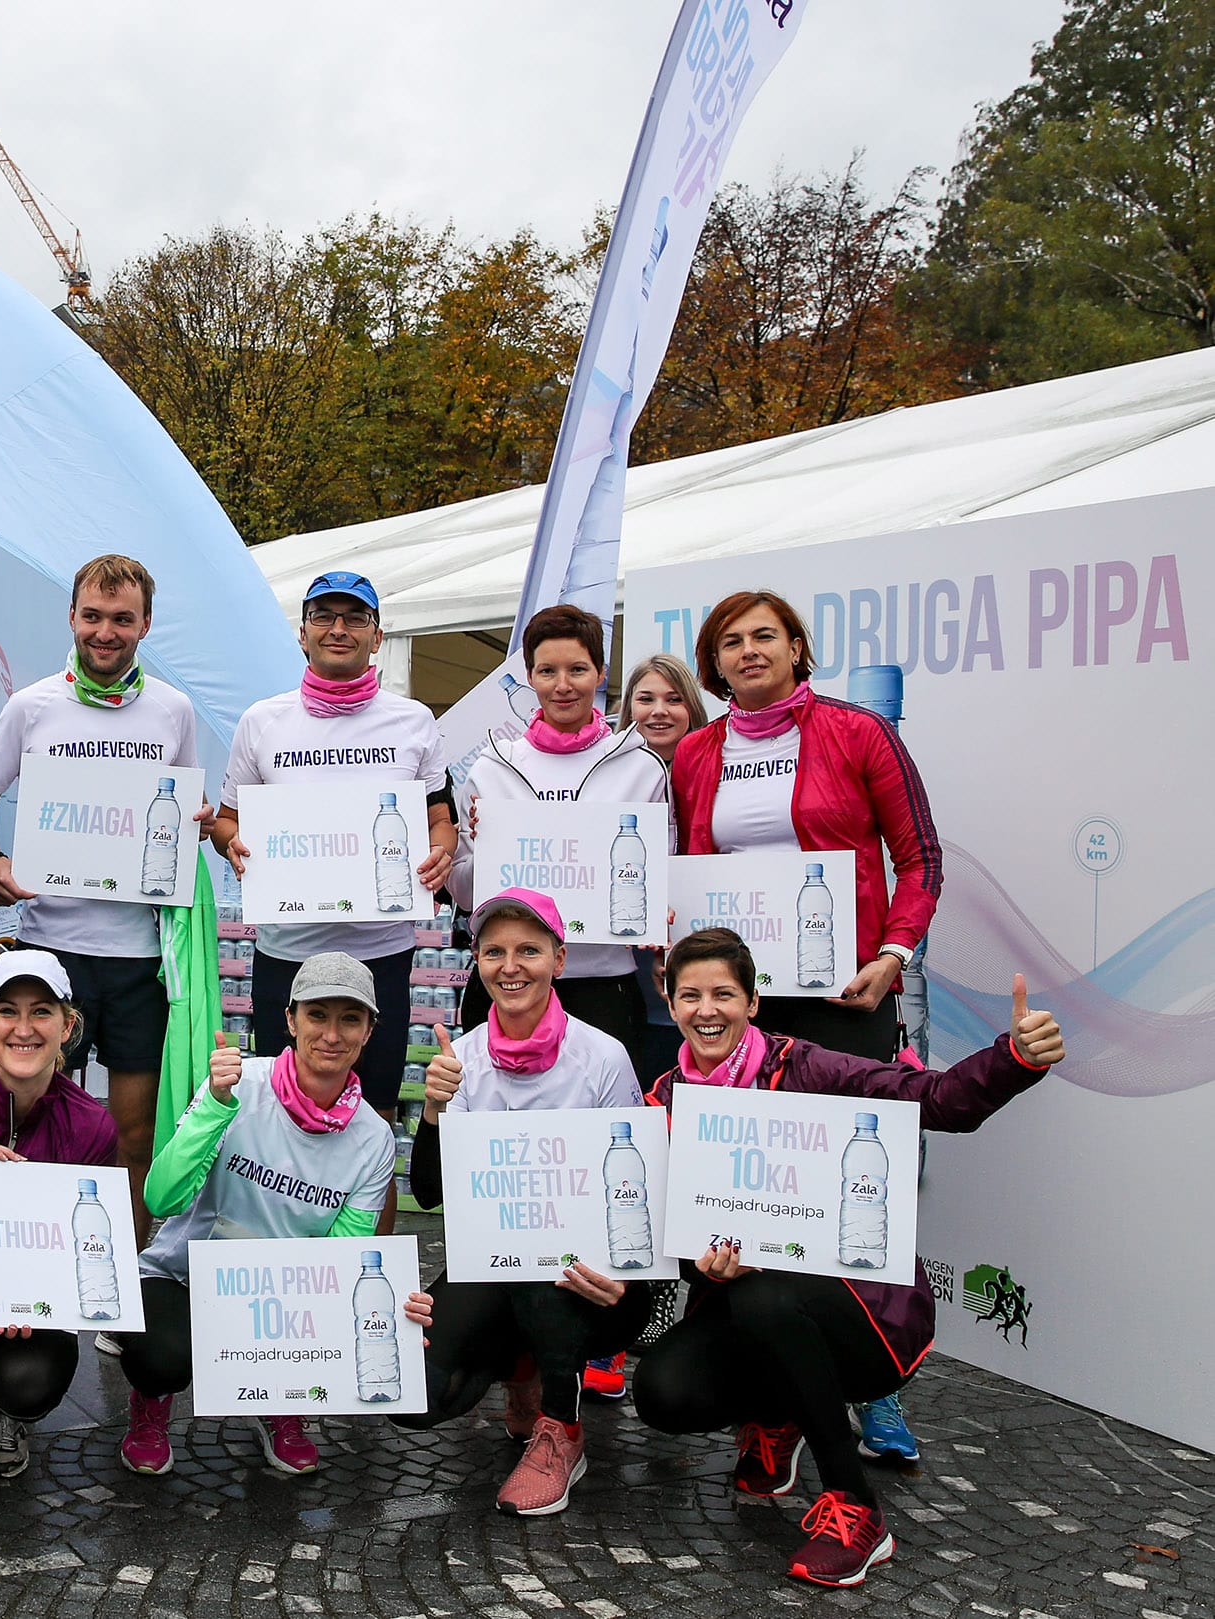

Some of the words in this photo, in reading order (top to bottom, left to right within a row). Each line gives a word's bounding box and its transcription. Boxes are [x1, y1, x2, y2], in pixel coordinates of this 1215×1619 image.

[812, 574, 1005, 681] DRUGA
[1028, 554, 1190, 670] PIPA
[273, 747, 397, 769] #ZMAGJEVECVRST
[38, 801, 135, 838] #ZMAGA
[152, 831, 173, 841] Zala
[1089, 834, 1105, 846] 42
[266, 830, 360, 859] #ČISTHUD
[381, 847, 402, 857] Zala
[517, 838, 556, 863] TEK
[559, 838, 579, 863] JE
[1086, 847, 1108, 861] km
[45, 873, 71, 886] Zala
[499, 863, 595, 890] SVOBODA!
[618, 869, 639, 879] Zala
[278, 901, 305, 912] Zala
[705, 892, 743, 916] TEK
[746, 891, 765, 915] JE
[244, 926, 257, 936] Za
[804, 919, 826, 930] Zala
[697, 1112, 759, 1147] MOJA
[767, 1118, 829, 1153] PRVA
[489, 1132, 531, 1166] DEŽ
[538, 1136, 567, 1165] SO
[729, 1147, 799, 1195] 10KA
[470, 1169, 562, 1199] KONFETI
[569, 1168, 590, 1196] IZ
[850, 1182, 878, 1195] Zala
[613, 1189, 639, 1200] Zala
[694, 1193, 825, 1220] #mojadrugapipa
[499, 1201, 565, 1230] NEBA.
[82, 1241, 105, 1253] Zala
[490, 1255, 522, 1268] Zala
[216, 1266, 275, 1296] MOJA
[282, 1265, 340, 1295] PRVA
[248, 1297, 316, 1340] 10KA
[363, 1319, 388, 1330] Zala
[219, 1348, 342, 1364] #mojadrugapipa
[237, 1387, 269, 1401] Zala
